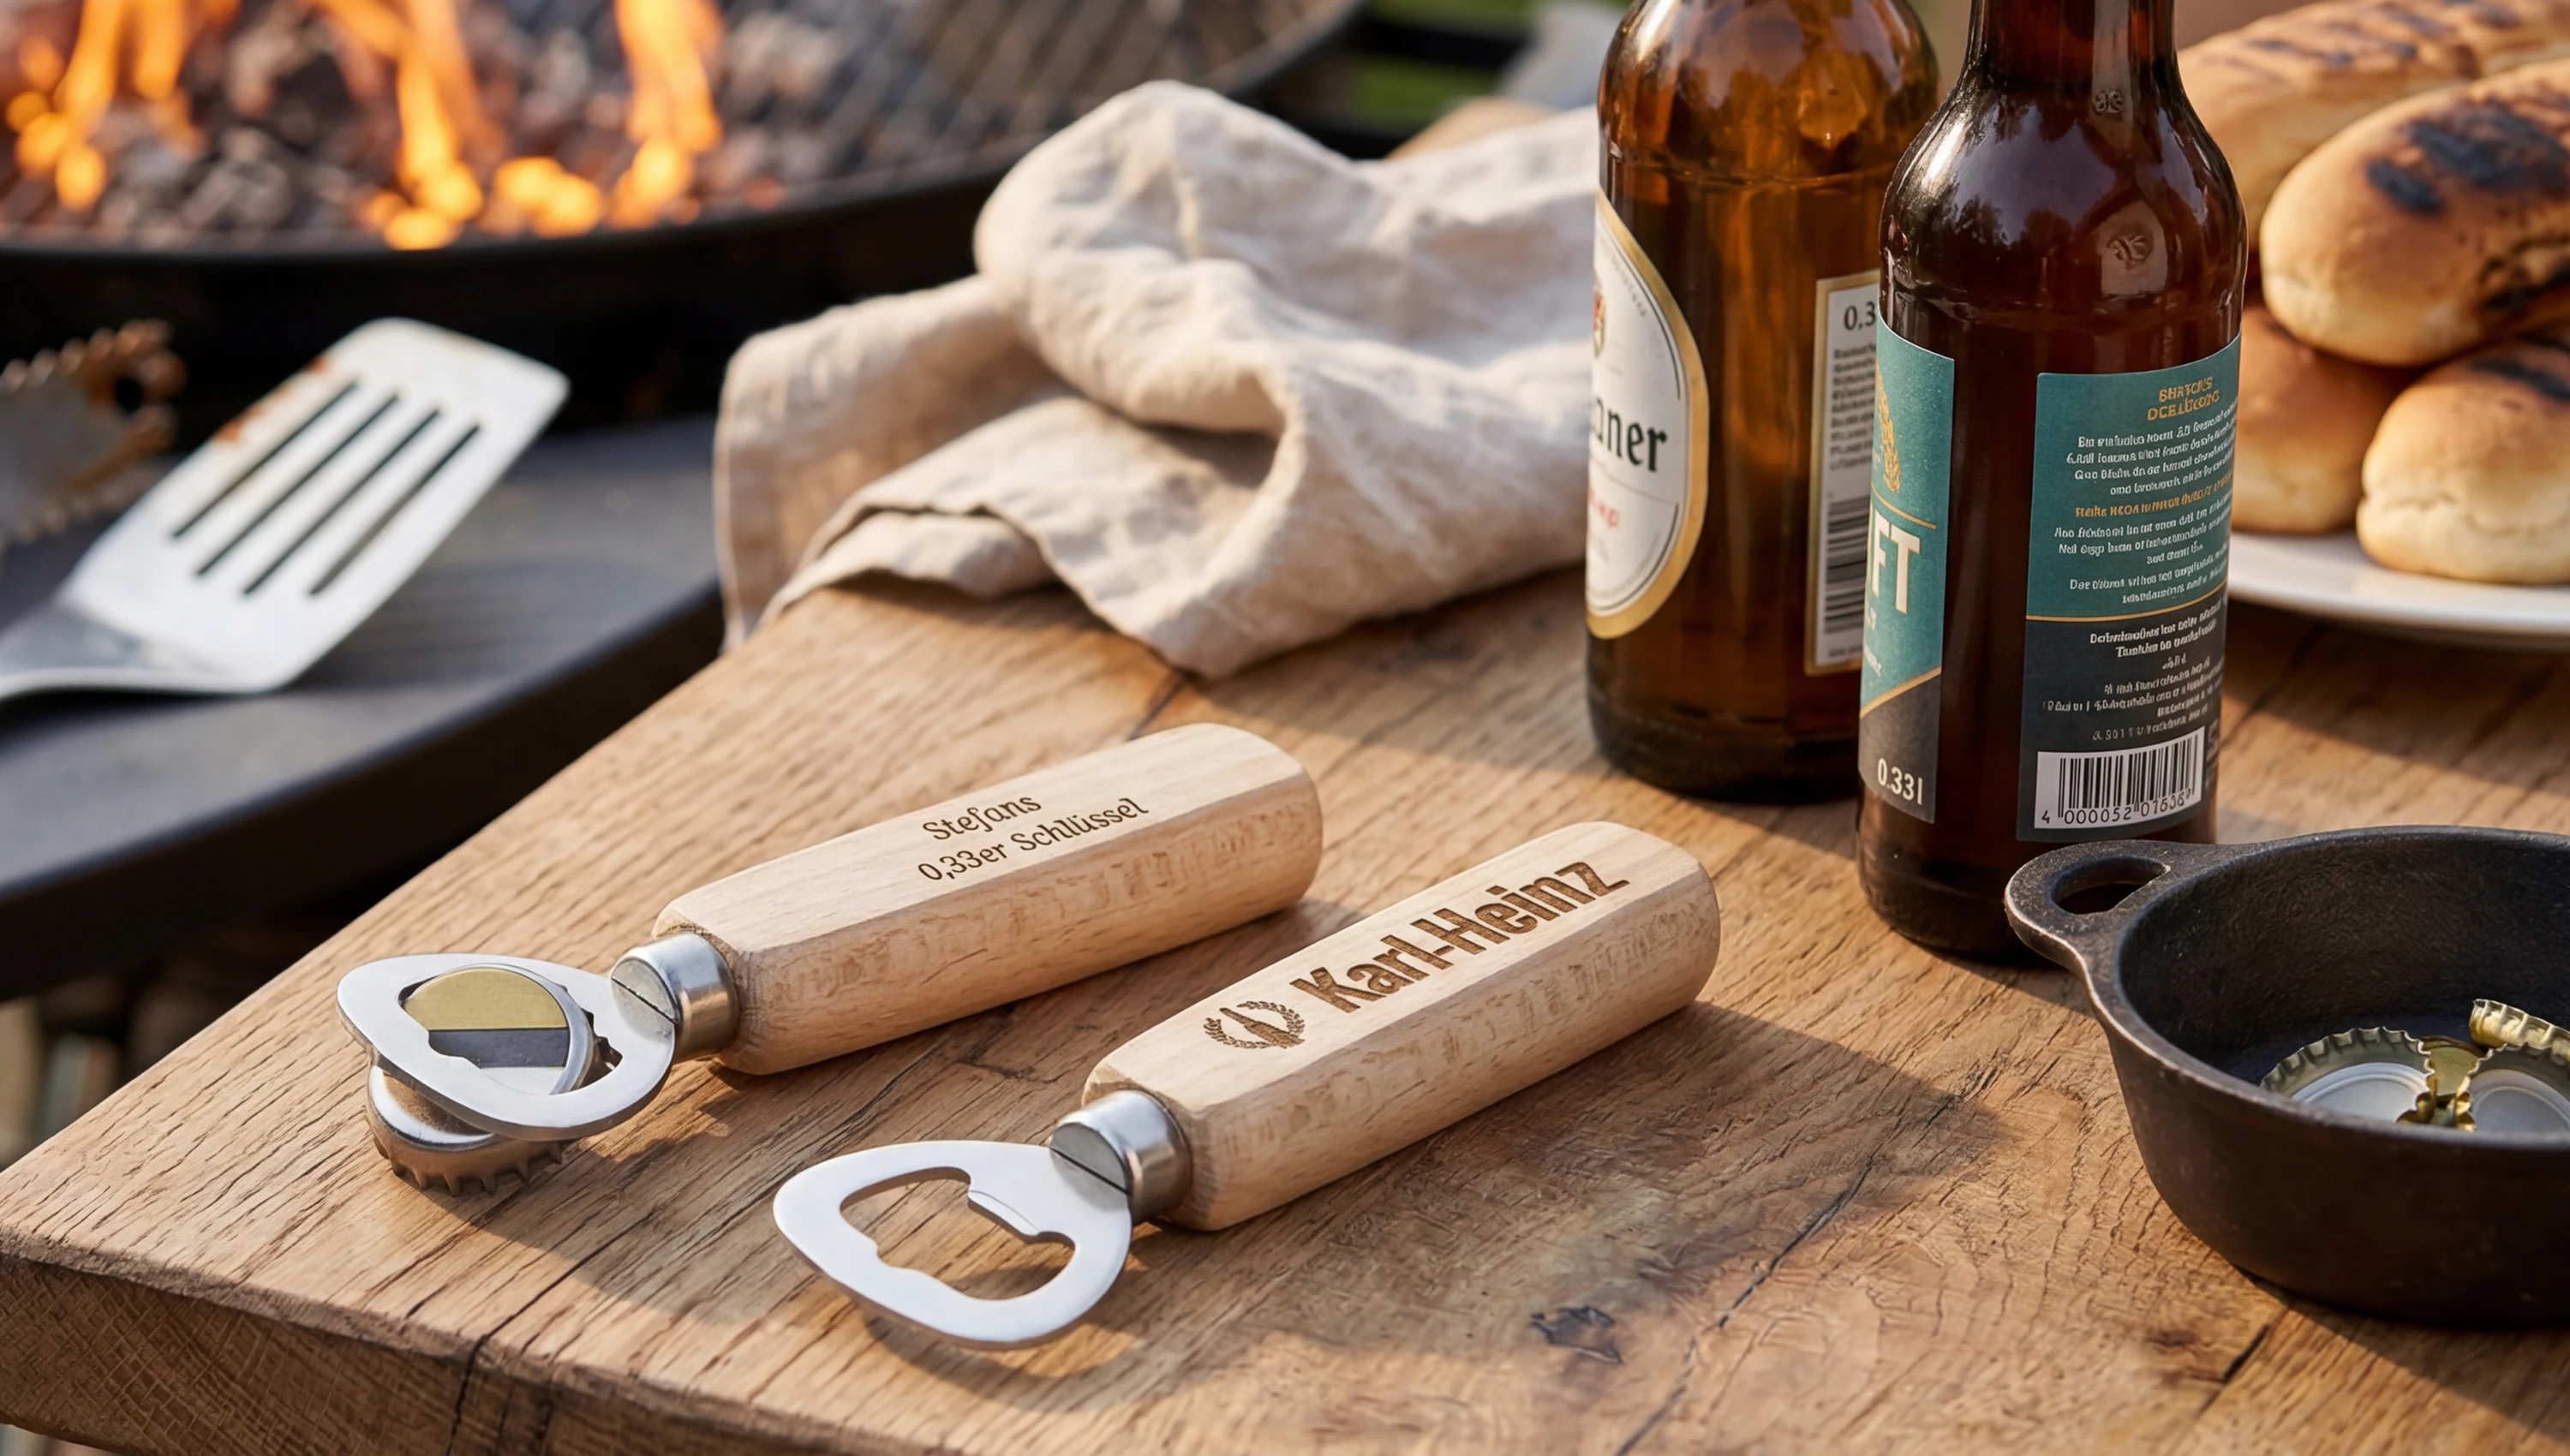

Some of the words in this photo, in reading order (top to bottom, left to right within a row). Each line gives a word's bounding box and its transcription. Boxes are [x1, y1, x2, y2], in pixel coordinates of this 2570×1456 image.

[1866, 501, 1921, 615] FT
[917, 843, 1008, 880] 0,33er
[1010, 798, 1149, 850] Schlüssel
[2064, 807, 2132, 825] 000052
[1289, 861, 1630, 1013] Karl-Heinz
